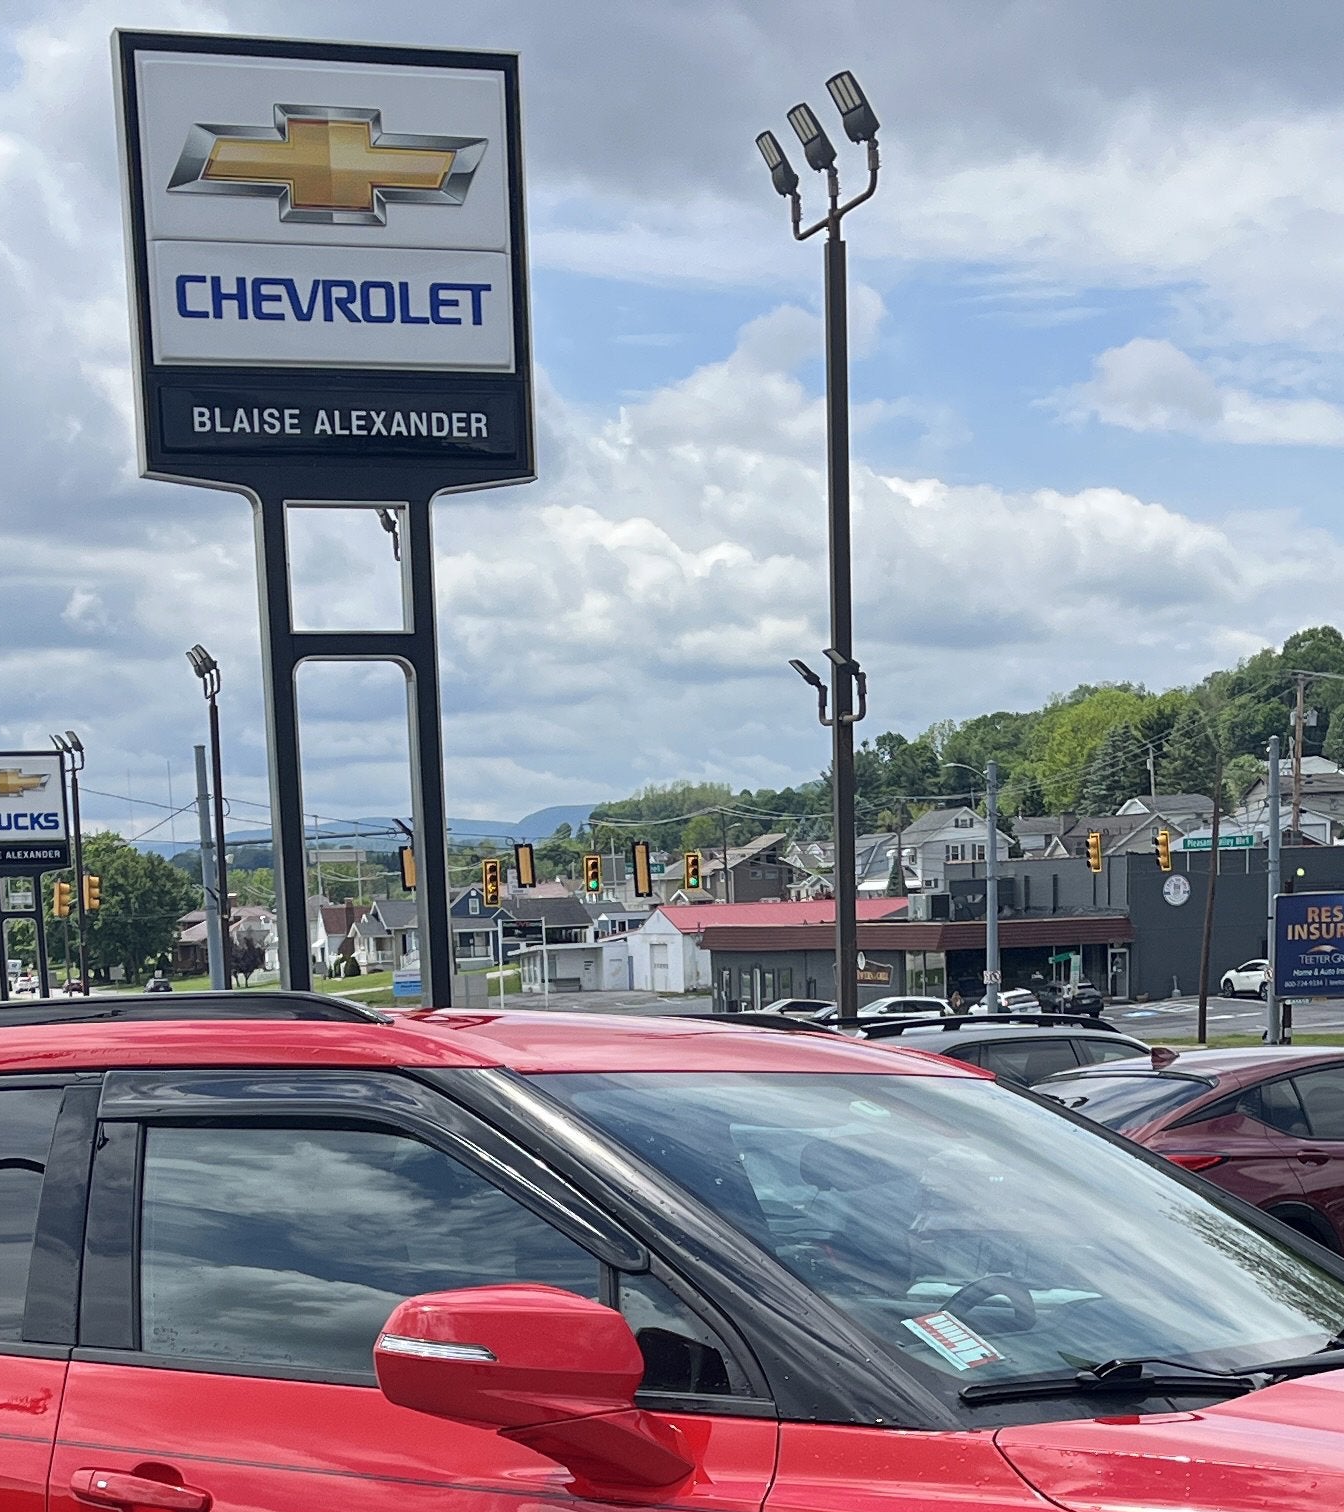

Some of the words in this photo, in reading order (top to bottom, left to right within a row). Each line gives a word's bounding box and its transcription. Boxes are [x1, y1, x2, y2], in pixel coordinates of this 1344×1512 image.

[175, 273, 492, 326] CHEVROLET
[192, 405, 302, 436] BLAISE
[313, 408, 489, 439] ALEXANDER
[5, 849, 61, 860] ALEXANDER
[1299, 954, 1332, 965] TEETER
[1320, 966, 1336, 976] Auto
